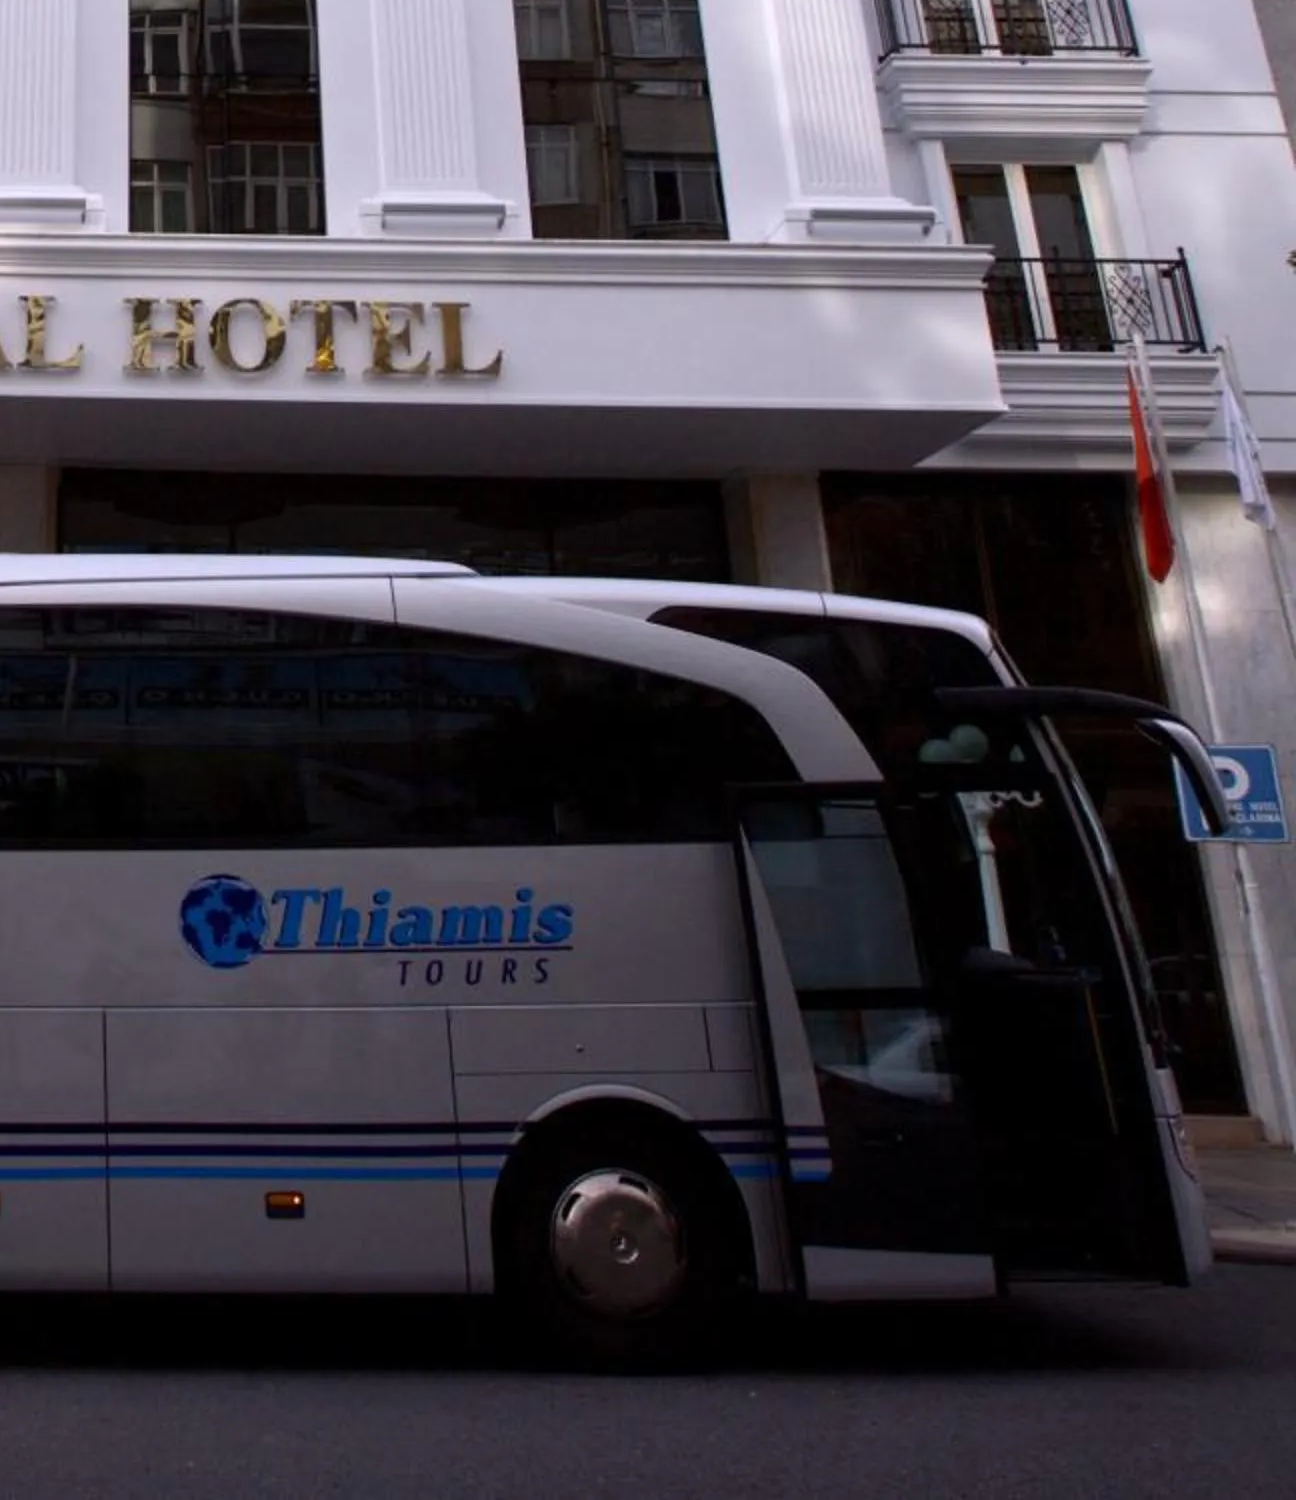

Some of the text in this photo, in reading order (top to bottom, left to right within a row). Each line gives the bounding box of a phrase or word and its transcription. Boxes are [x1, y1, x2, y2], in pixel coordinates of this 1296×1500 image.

[122, 296, 503, 380] HOTEL
[270, 886, 574, 948] Thiamis
[397, 957, 550, 986] TOURS
